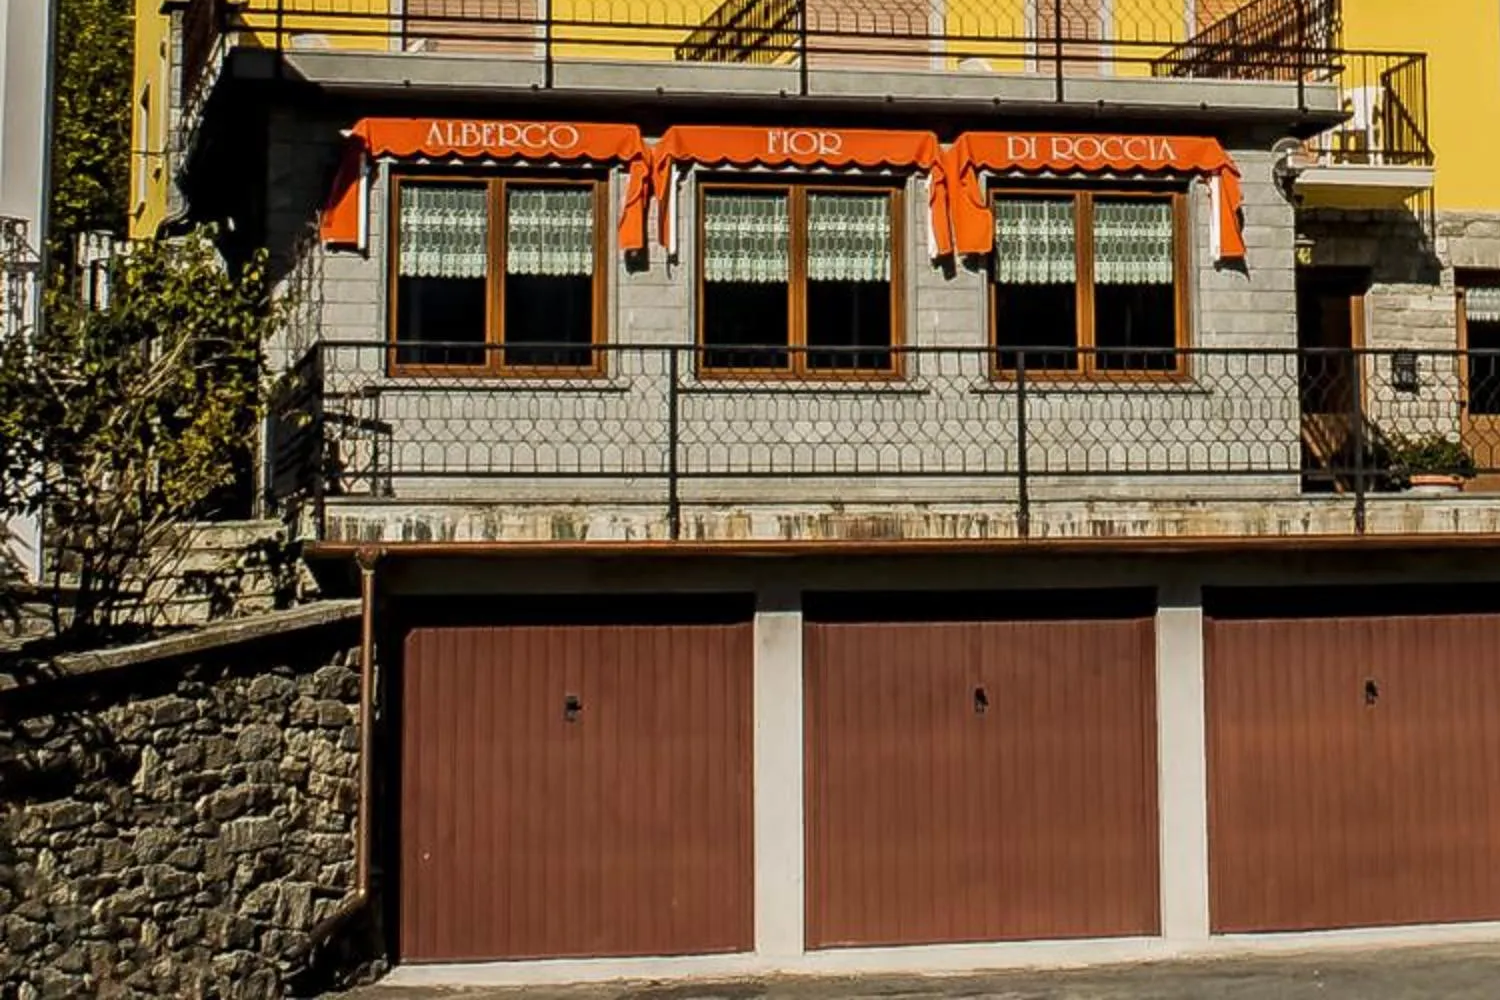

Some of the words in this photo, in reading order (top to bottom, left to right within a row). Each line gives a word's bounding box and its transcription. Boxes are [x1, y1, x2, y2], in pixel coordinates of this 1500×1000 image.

[424, 121, 580, 149] ALBERGO
[767, 130, 842, 155] FIOR
[1007, 136, 1036, 161] DI
[1051, 137, 1177, 162] ROCCIA
